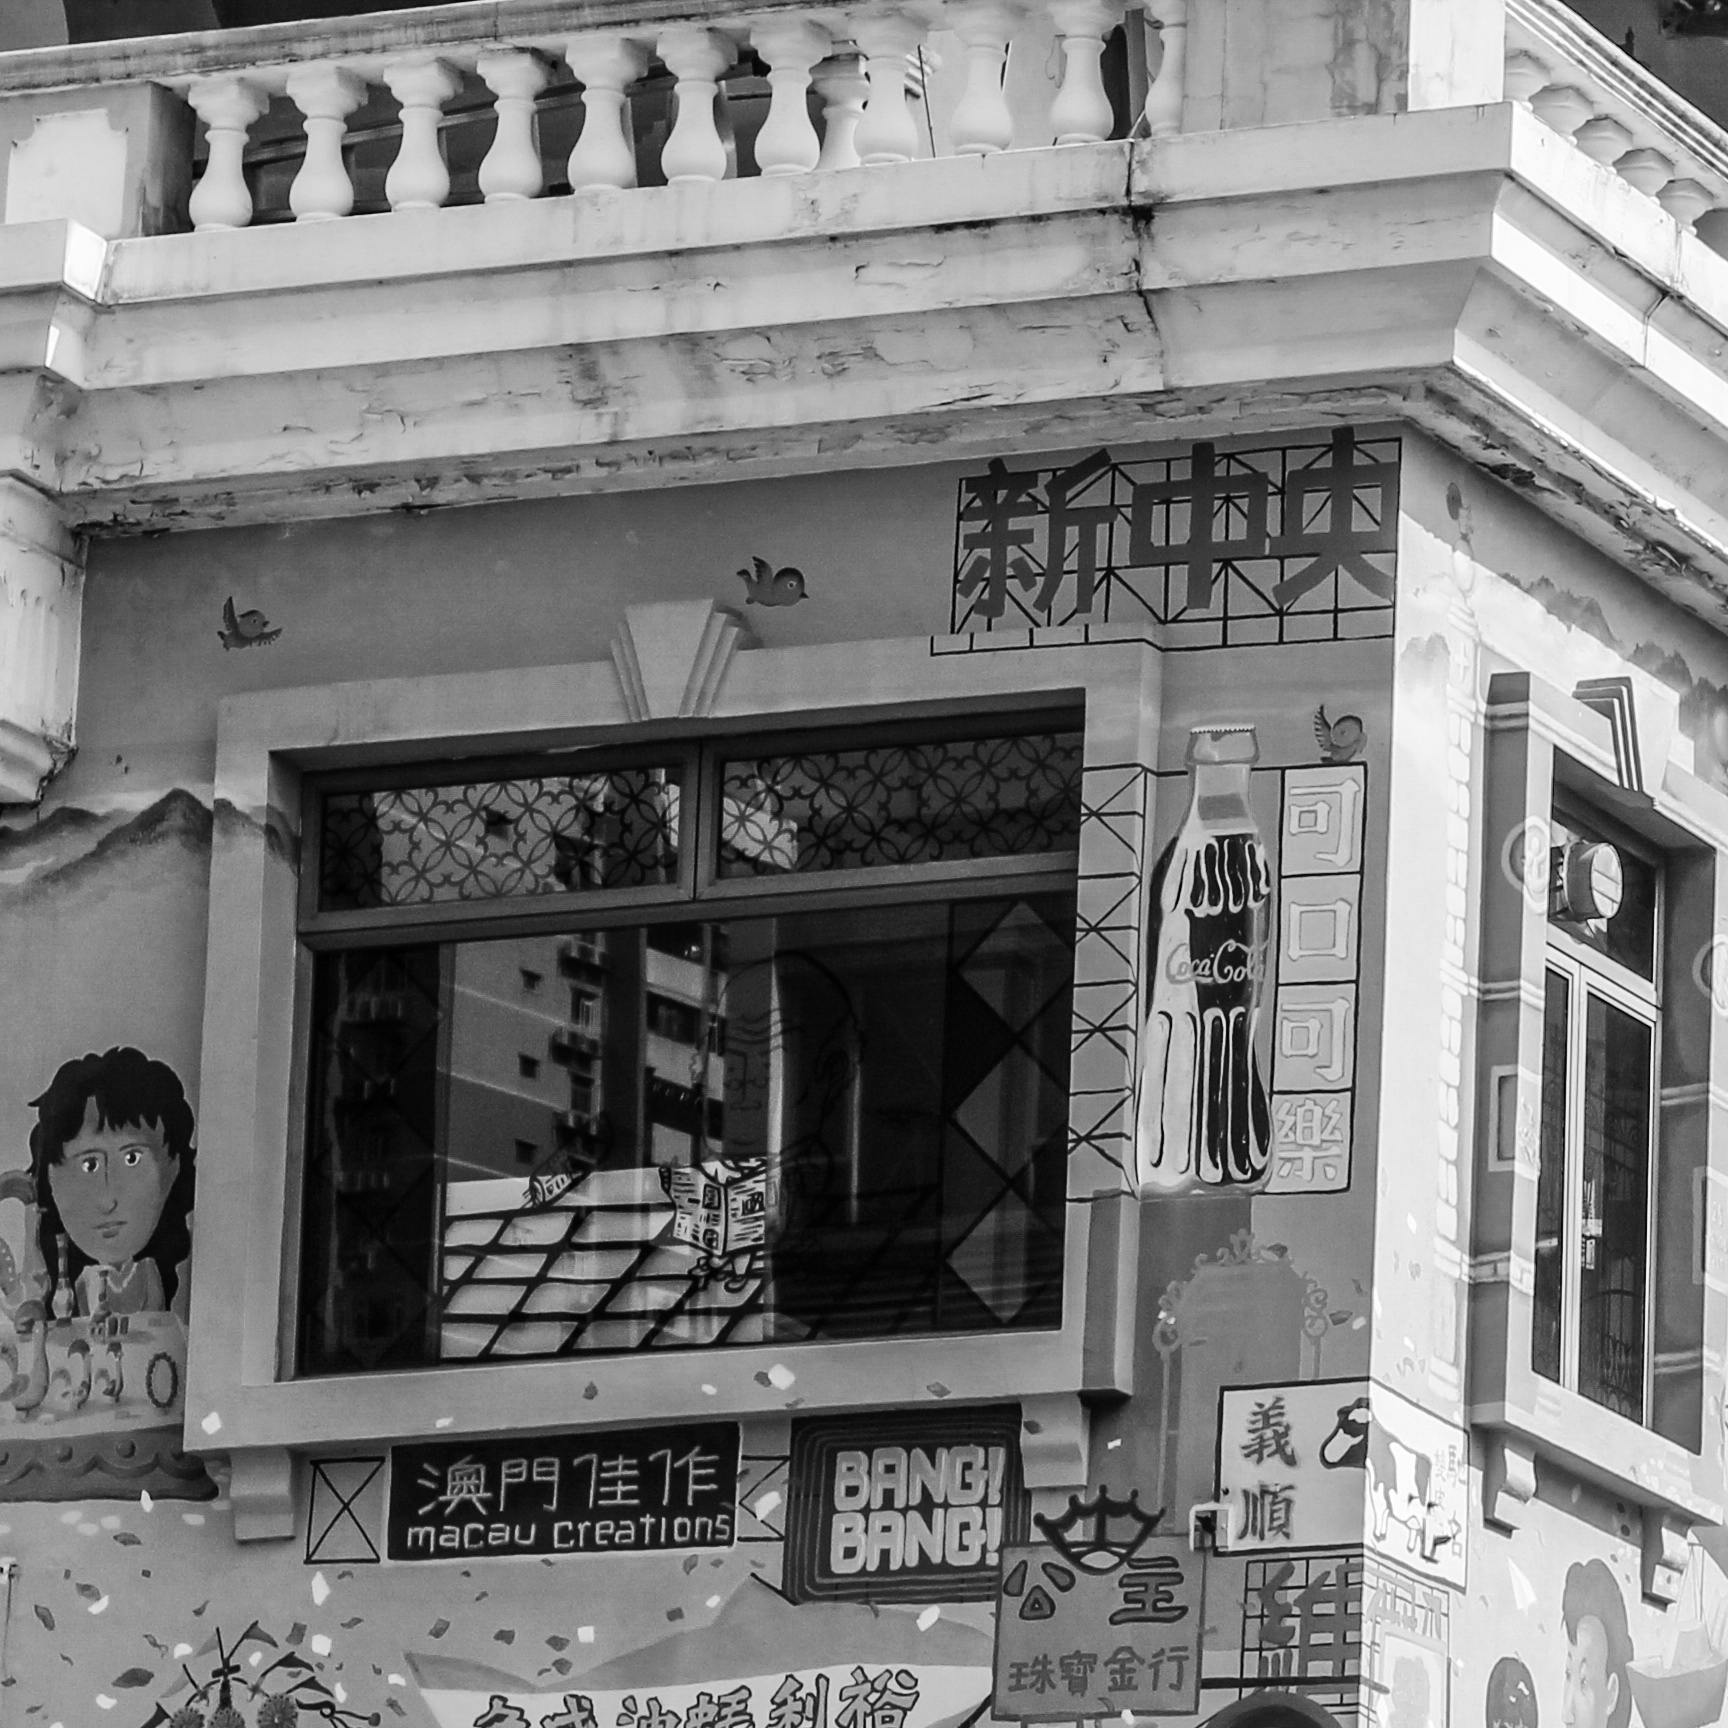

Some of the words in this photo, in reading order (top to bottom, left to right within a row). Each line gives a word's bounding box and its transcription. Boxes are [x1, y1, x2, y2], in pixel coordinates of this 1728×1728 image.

[957, 427, 1399, 618] 新中央
[417, 1448, 720, 1515] 澳門佳作
[554, 1511, 733, 1550] creations
